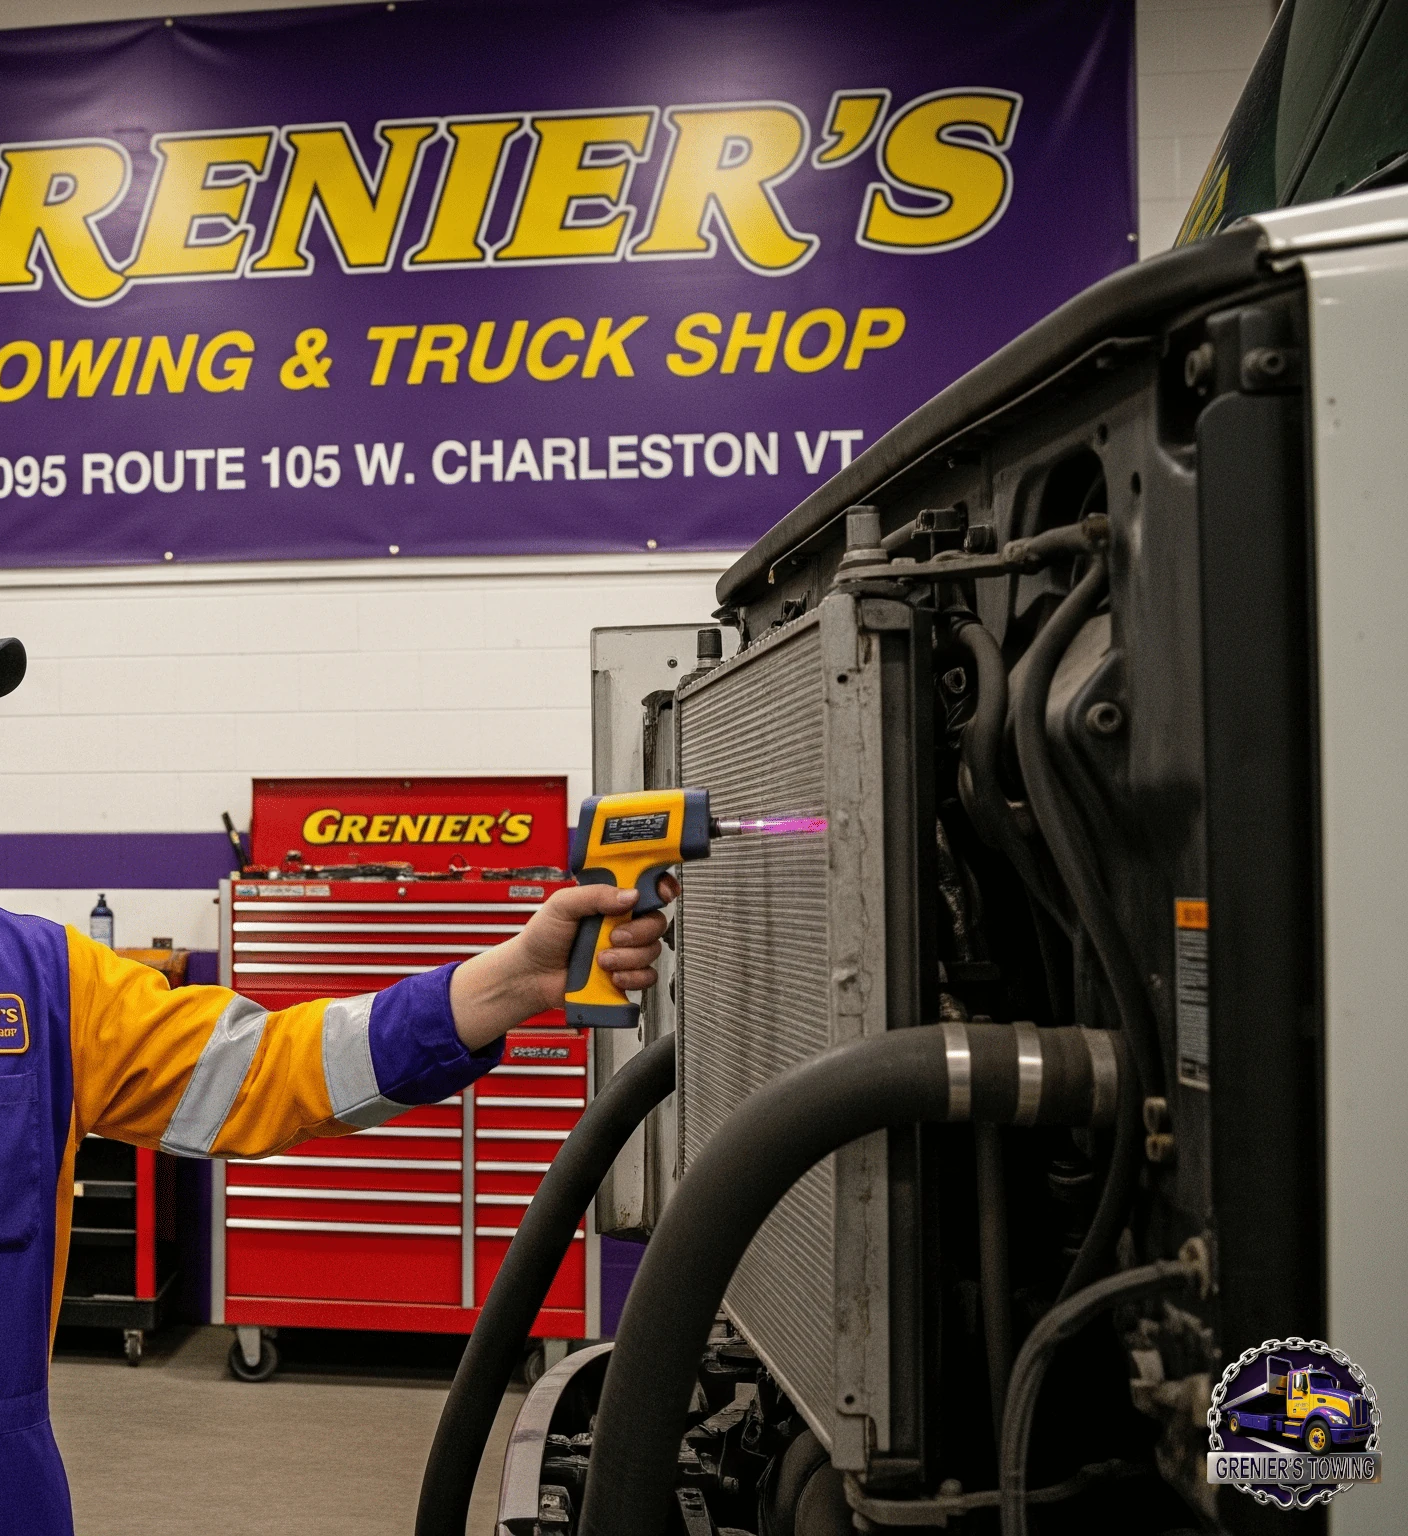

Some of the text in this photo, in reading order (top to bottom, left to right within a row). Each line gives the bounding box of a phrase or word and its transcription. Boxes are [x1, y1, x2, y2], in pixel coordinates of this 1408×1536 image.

[279, 328, 333, 390] &
[366, 315, 649, 387] TRUCK
[665, 307, 907, 378] SHOP
[82, 447, 246, 496] ROUTE
[261, 444, 340, 489] 105
[354, 442, 416, 486] W.
[431, 432, 779, 484] CHARLESTON
[794, 429, 864, 475] VT
[302, 808, 534, 845] GRENIER'S
